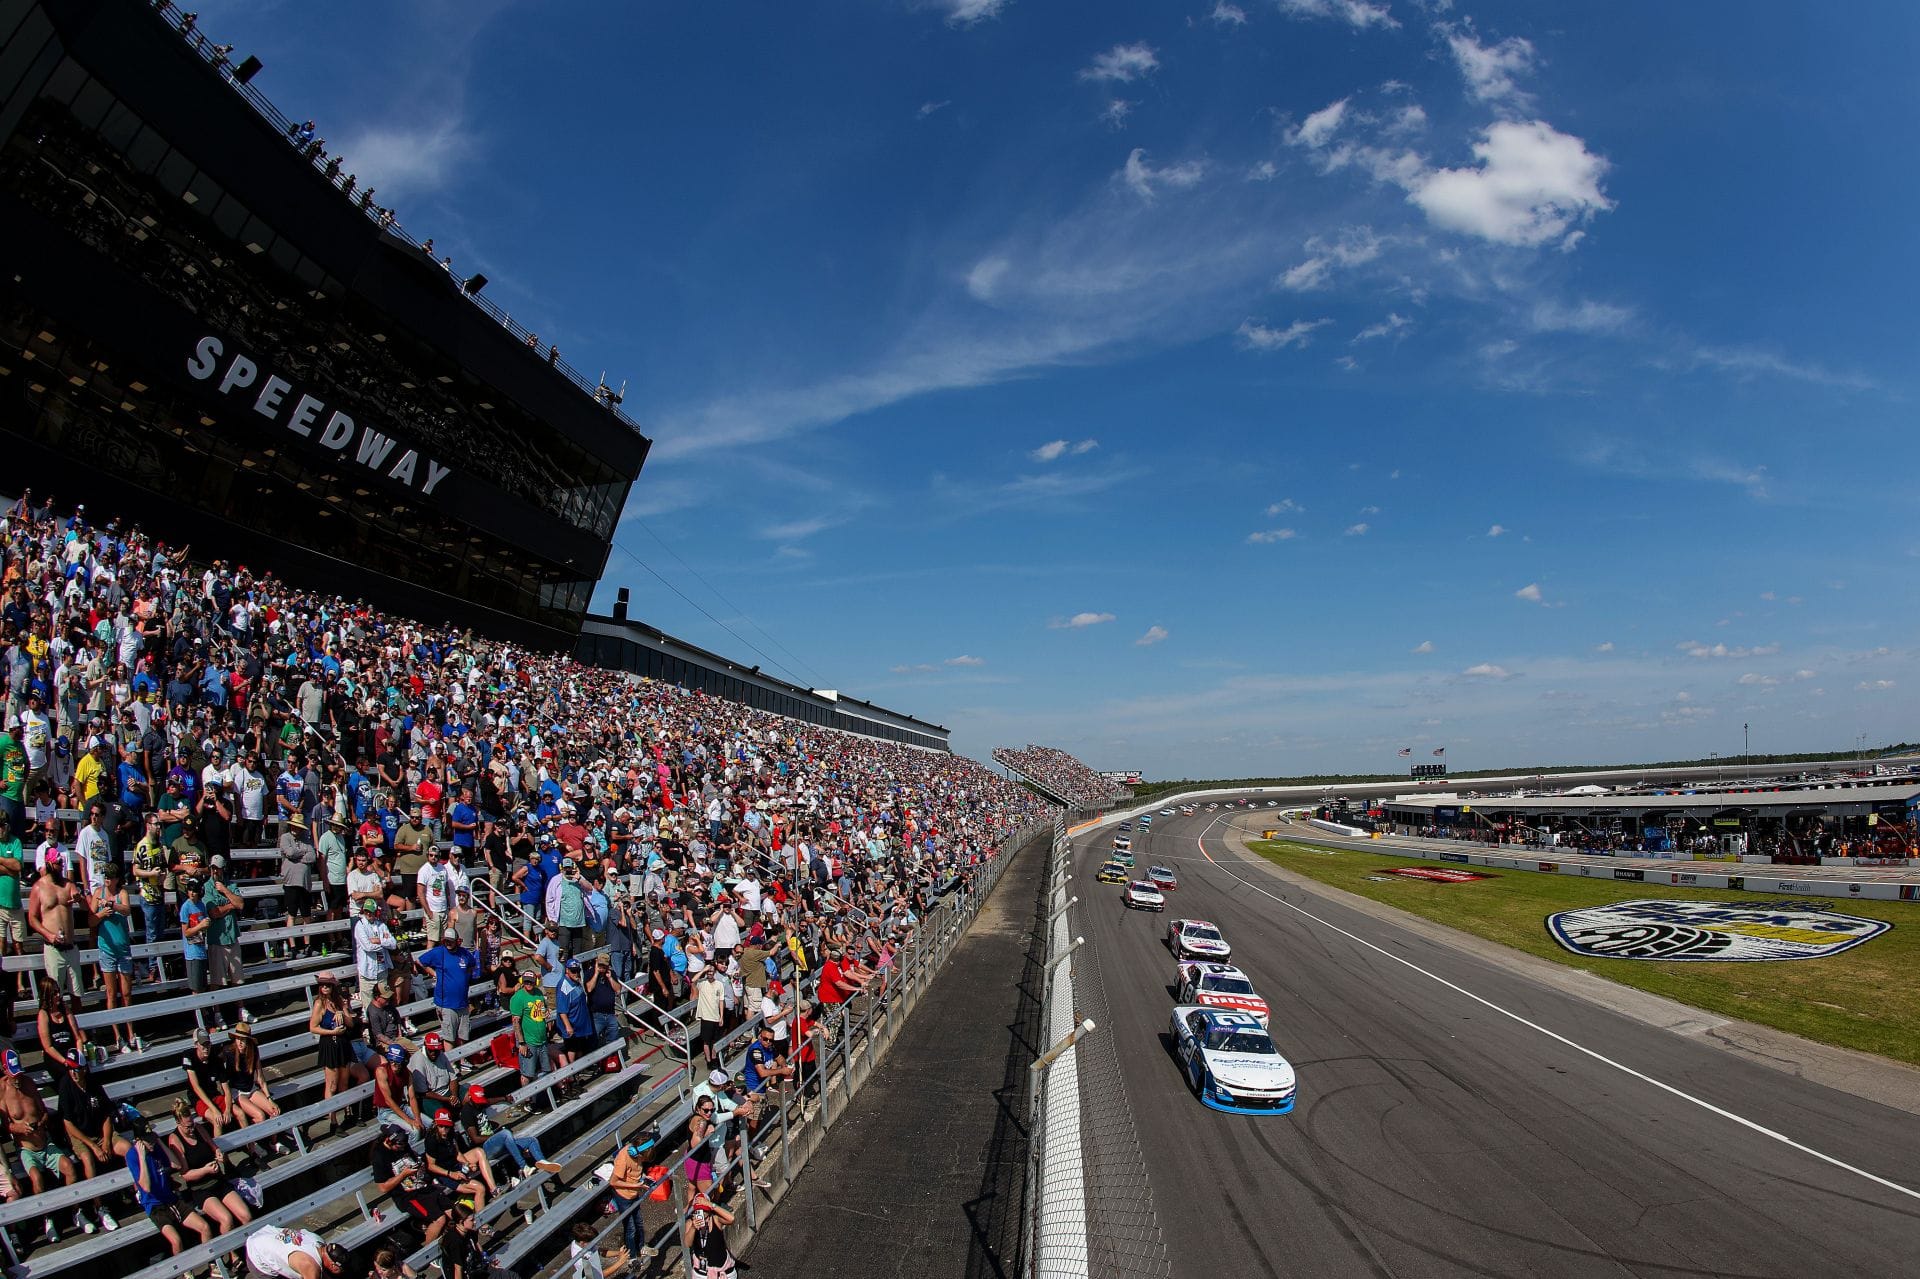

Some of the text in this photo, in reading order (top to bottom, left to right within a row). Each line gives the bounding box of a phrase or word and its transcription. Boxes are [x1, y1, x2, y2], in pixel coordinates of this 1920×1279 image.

[187, 336, 451, 495] SPEEDWAY
[1183, 983, 1194, 1004] 8
[1202, 995, 1267, 1008] pilot
[1212, 1058, 1286, 1067] BENNETT
